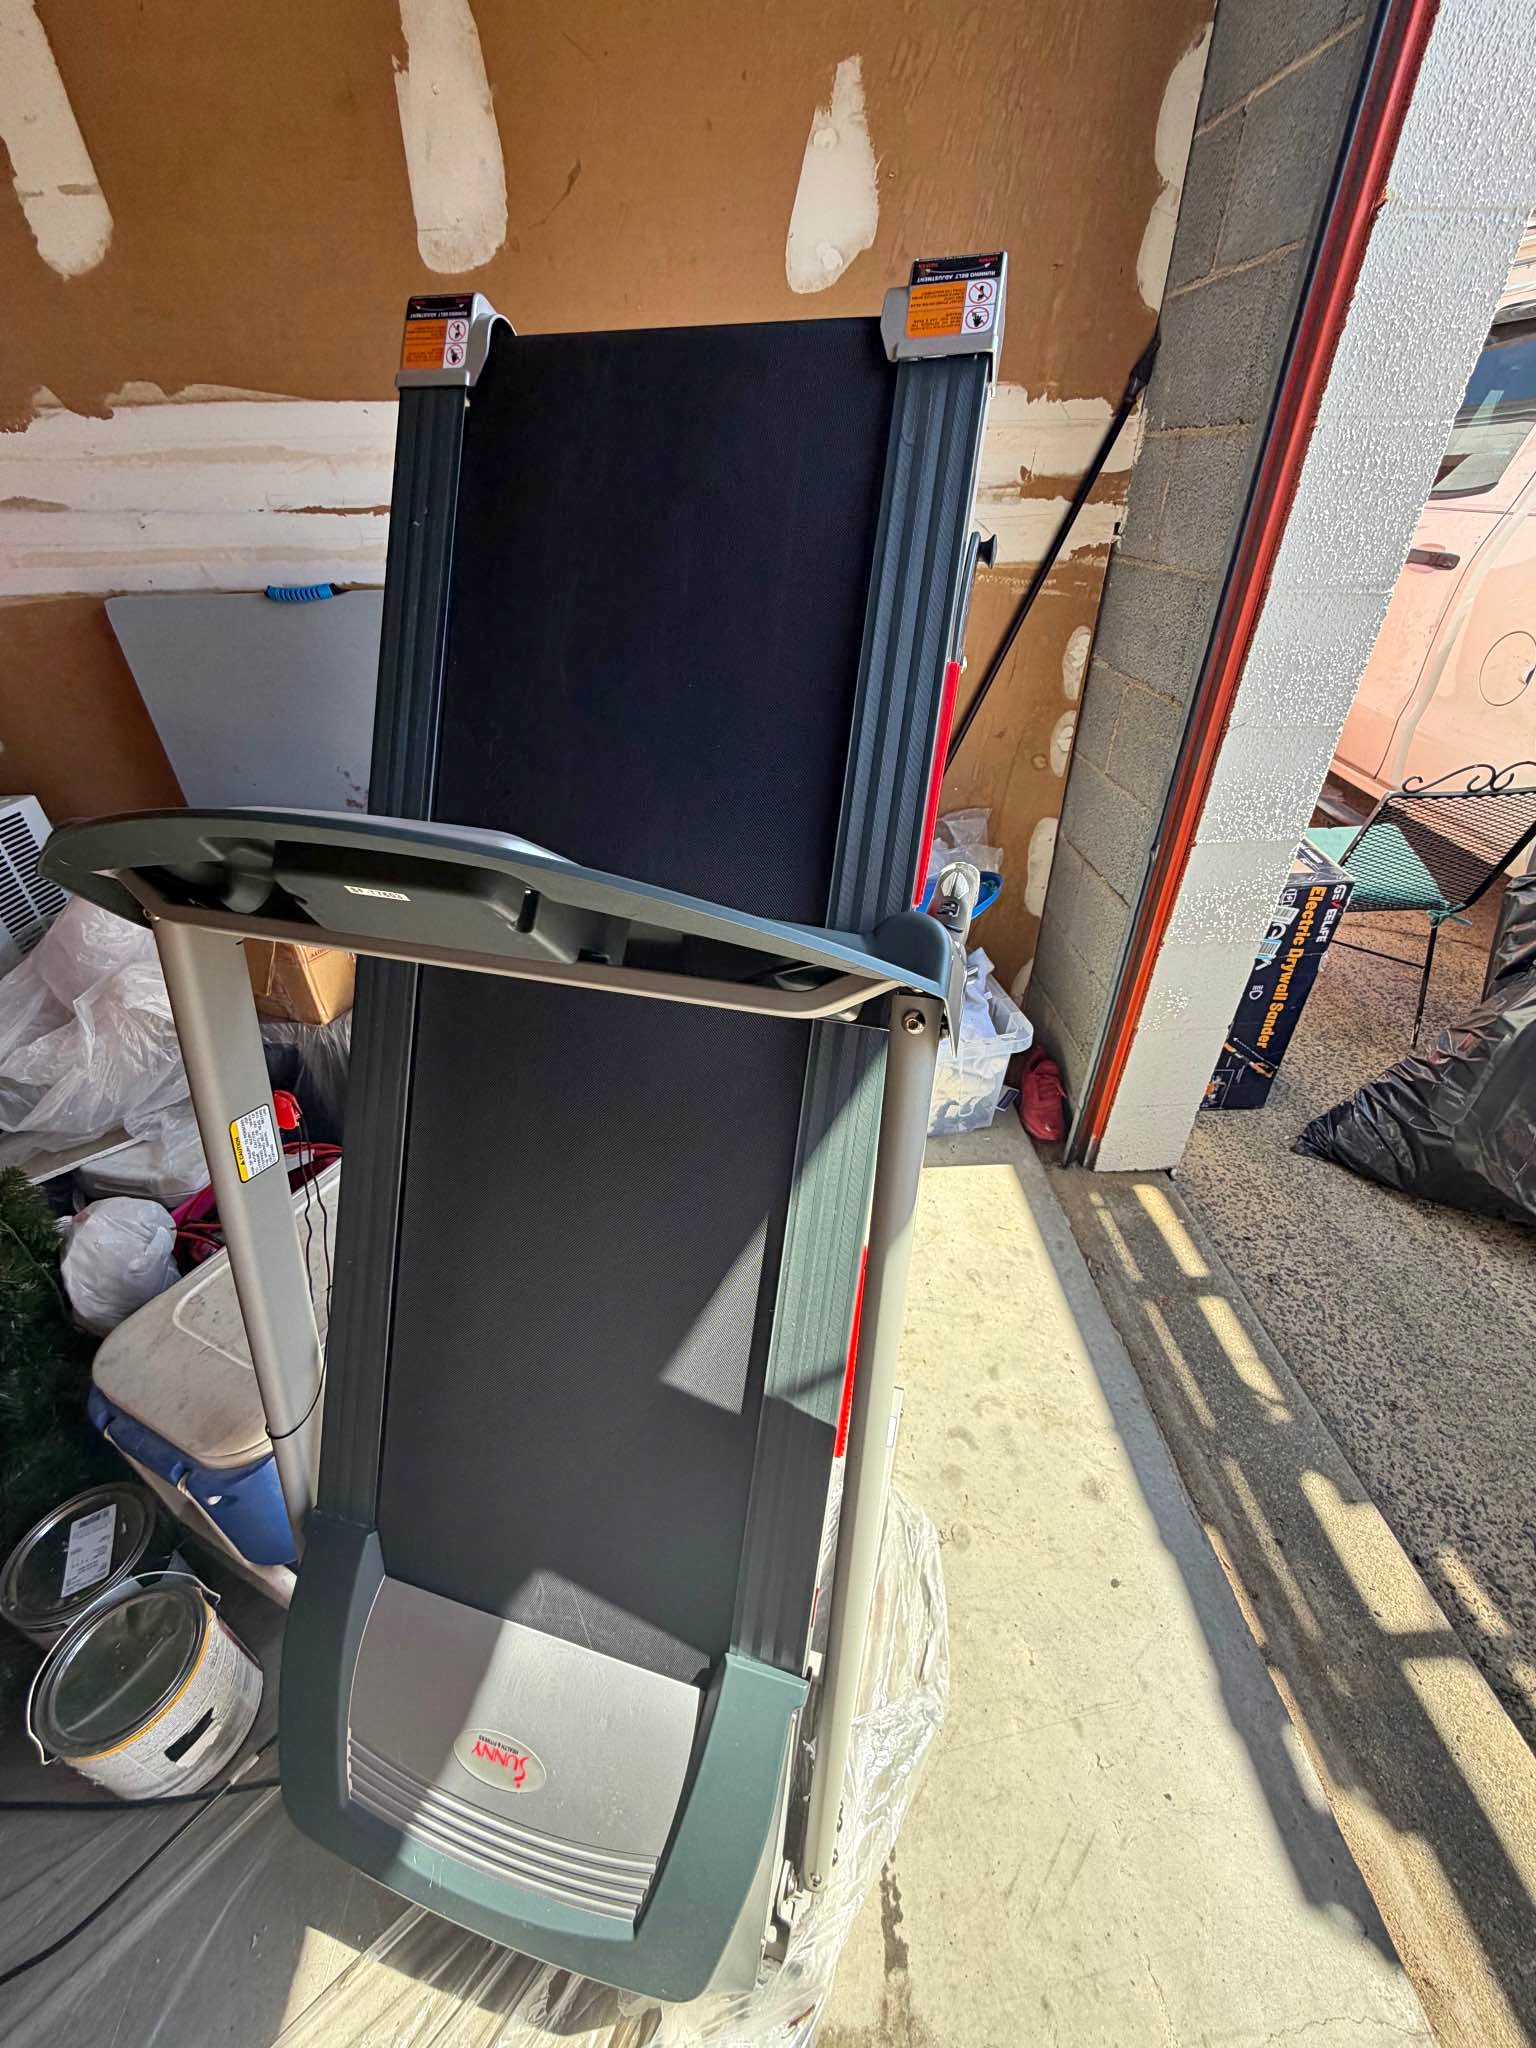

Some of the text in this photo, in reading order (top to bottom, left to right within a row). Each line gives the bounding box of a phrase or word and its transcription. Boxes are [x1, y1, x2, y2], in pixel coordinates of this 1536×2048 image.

[917, 274, 953, 283] ADJUSTMENT
[1292, 886, 1328, 946] Electric
[1272, 948, 1304, 1001] Drywall
[1256, 1002, 1285, 1049] Sander
[235, 1136, 244, 1160] CAUTION
[478, 1735, 497, 1747] FITNESS
[500, 1744, 519, 1755] HEALTH
[471, 1741, 529, 1789] SUNNY
